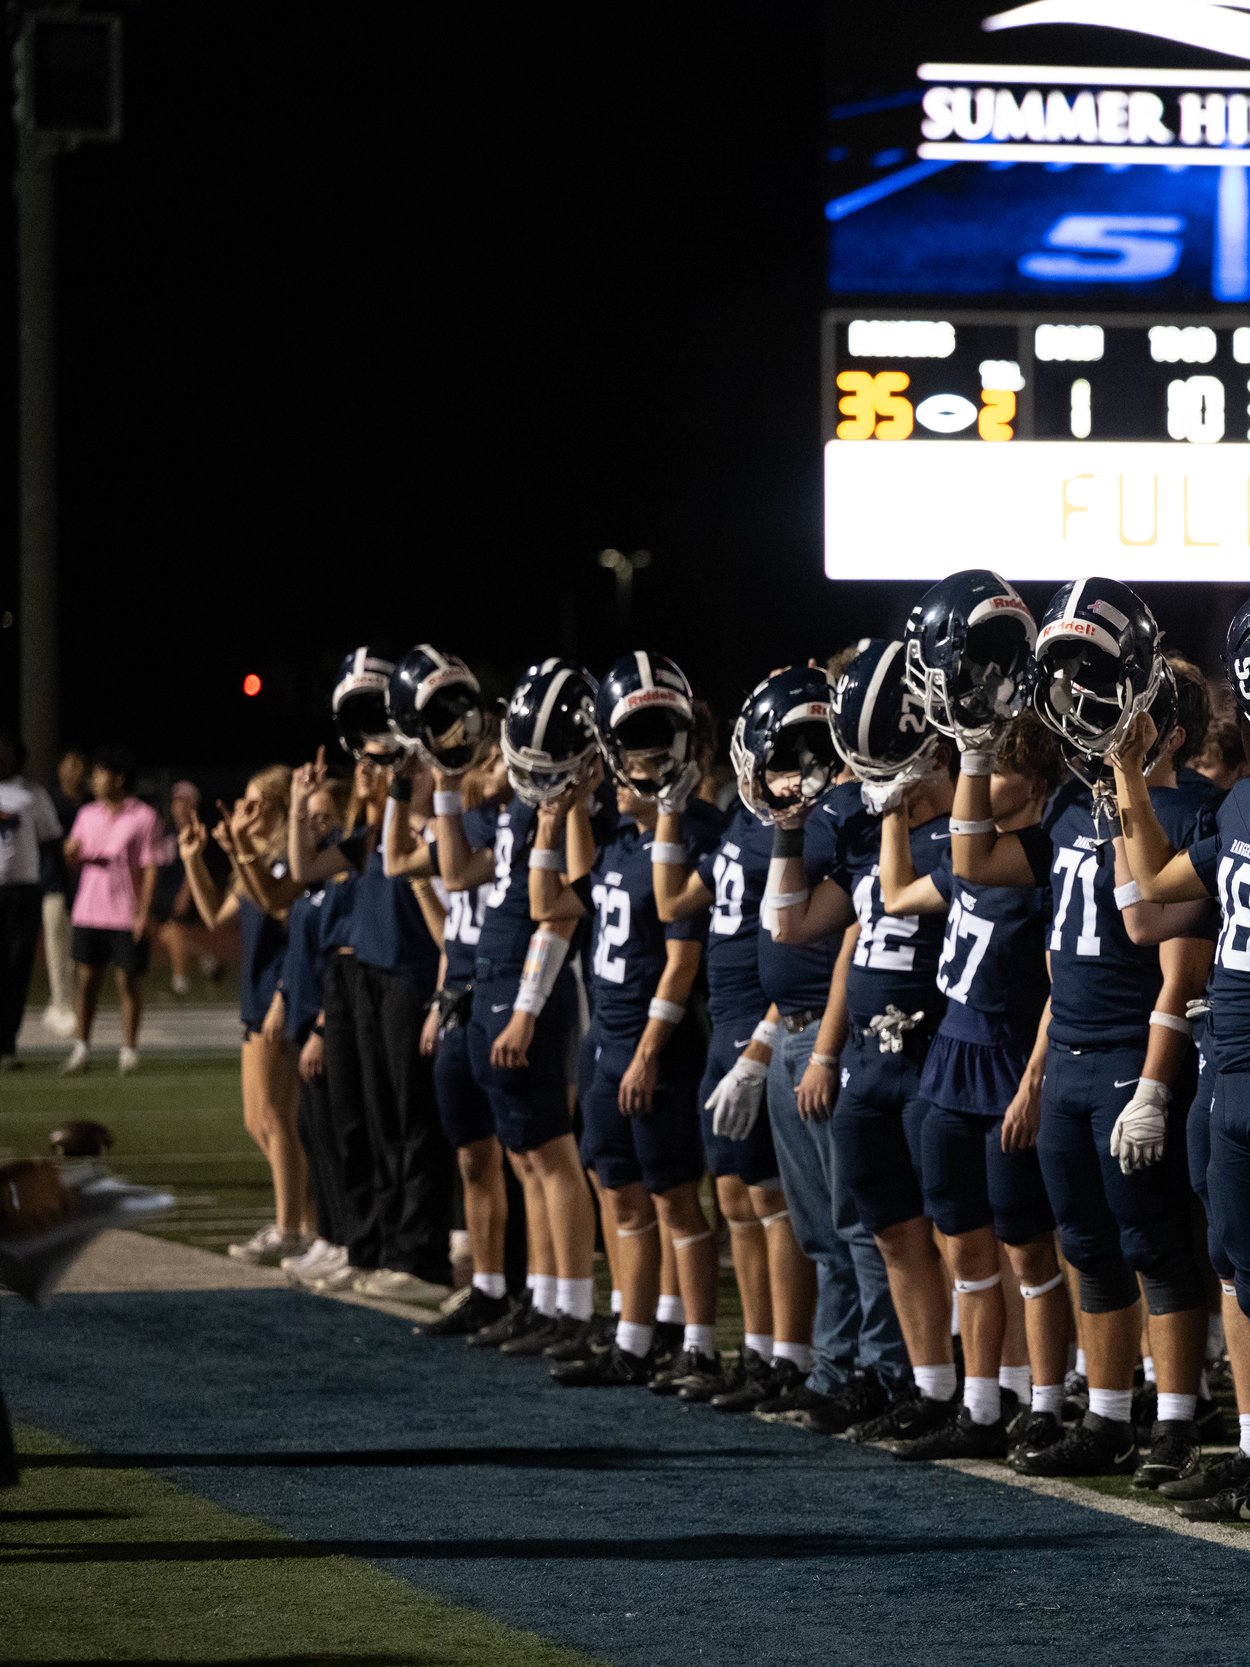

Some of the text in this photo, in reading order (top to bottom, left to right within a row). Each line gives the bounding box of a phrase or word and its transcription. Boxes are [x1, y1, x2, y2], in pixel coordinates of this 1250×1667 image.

[921, 87, 1174, 144] SUMMER
[1018, 212, 1187, 283] 5
[836, 371, 915, 441] 35
[1070, 378, 1092, 439] 1
[1167, 376, 1225, 444] 10
[1050, 847, 1101, 957] 71
